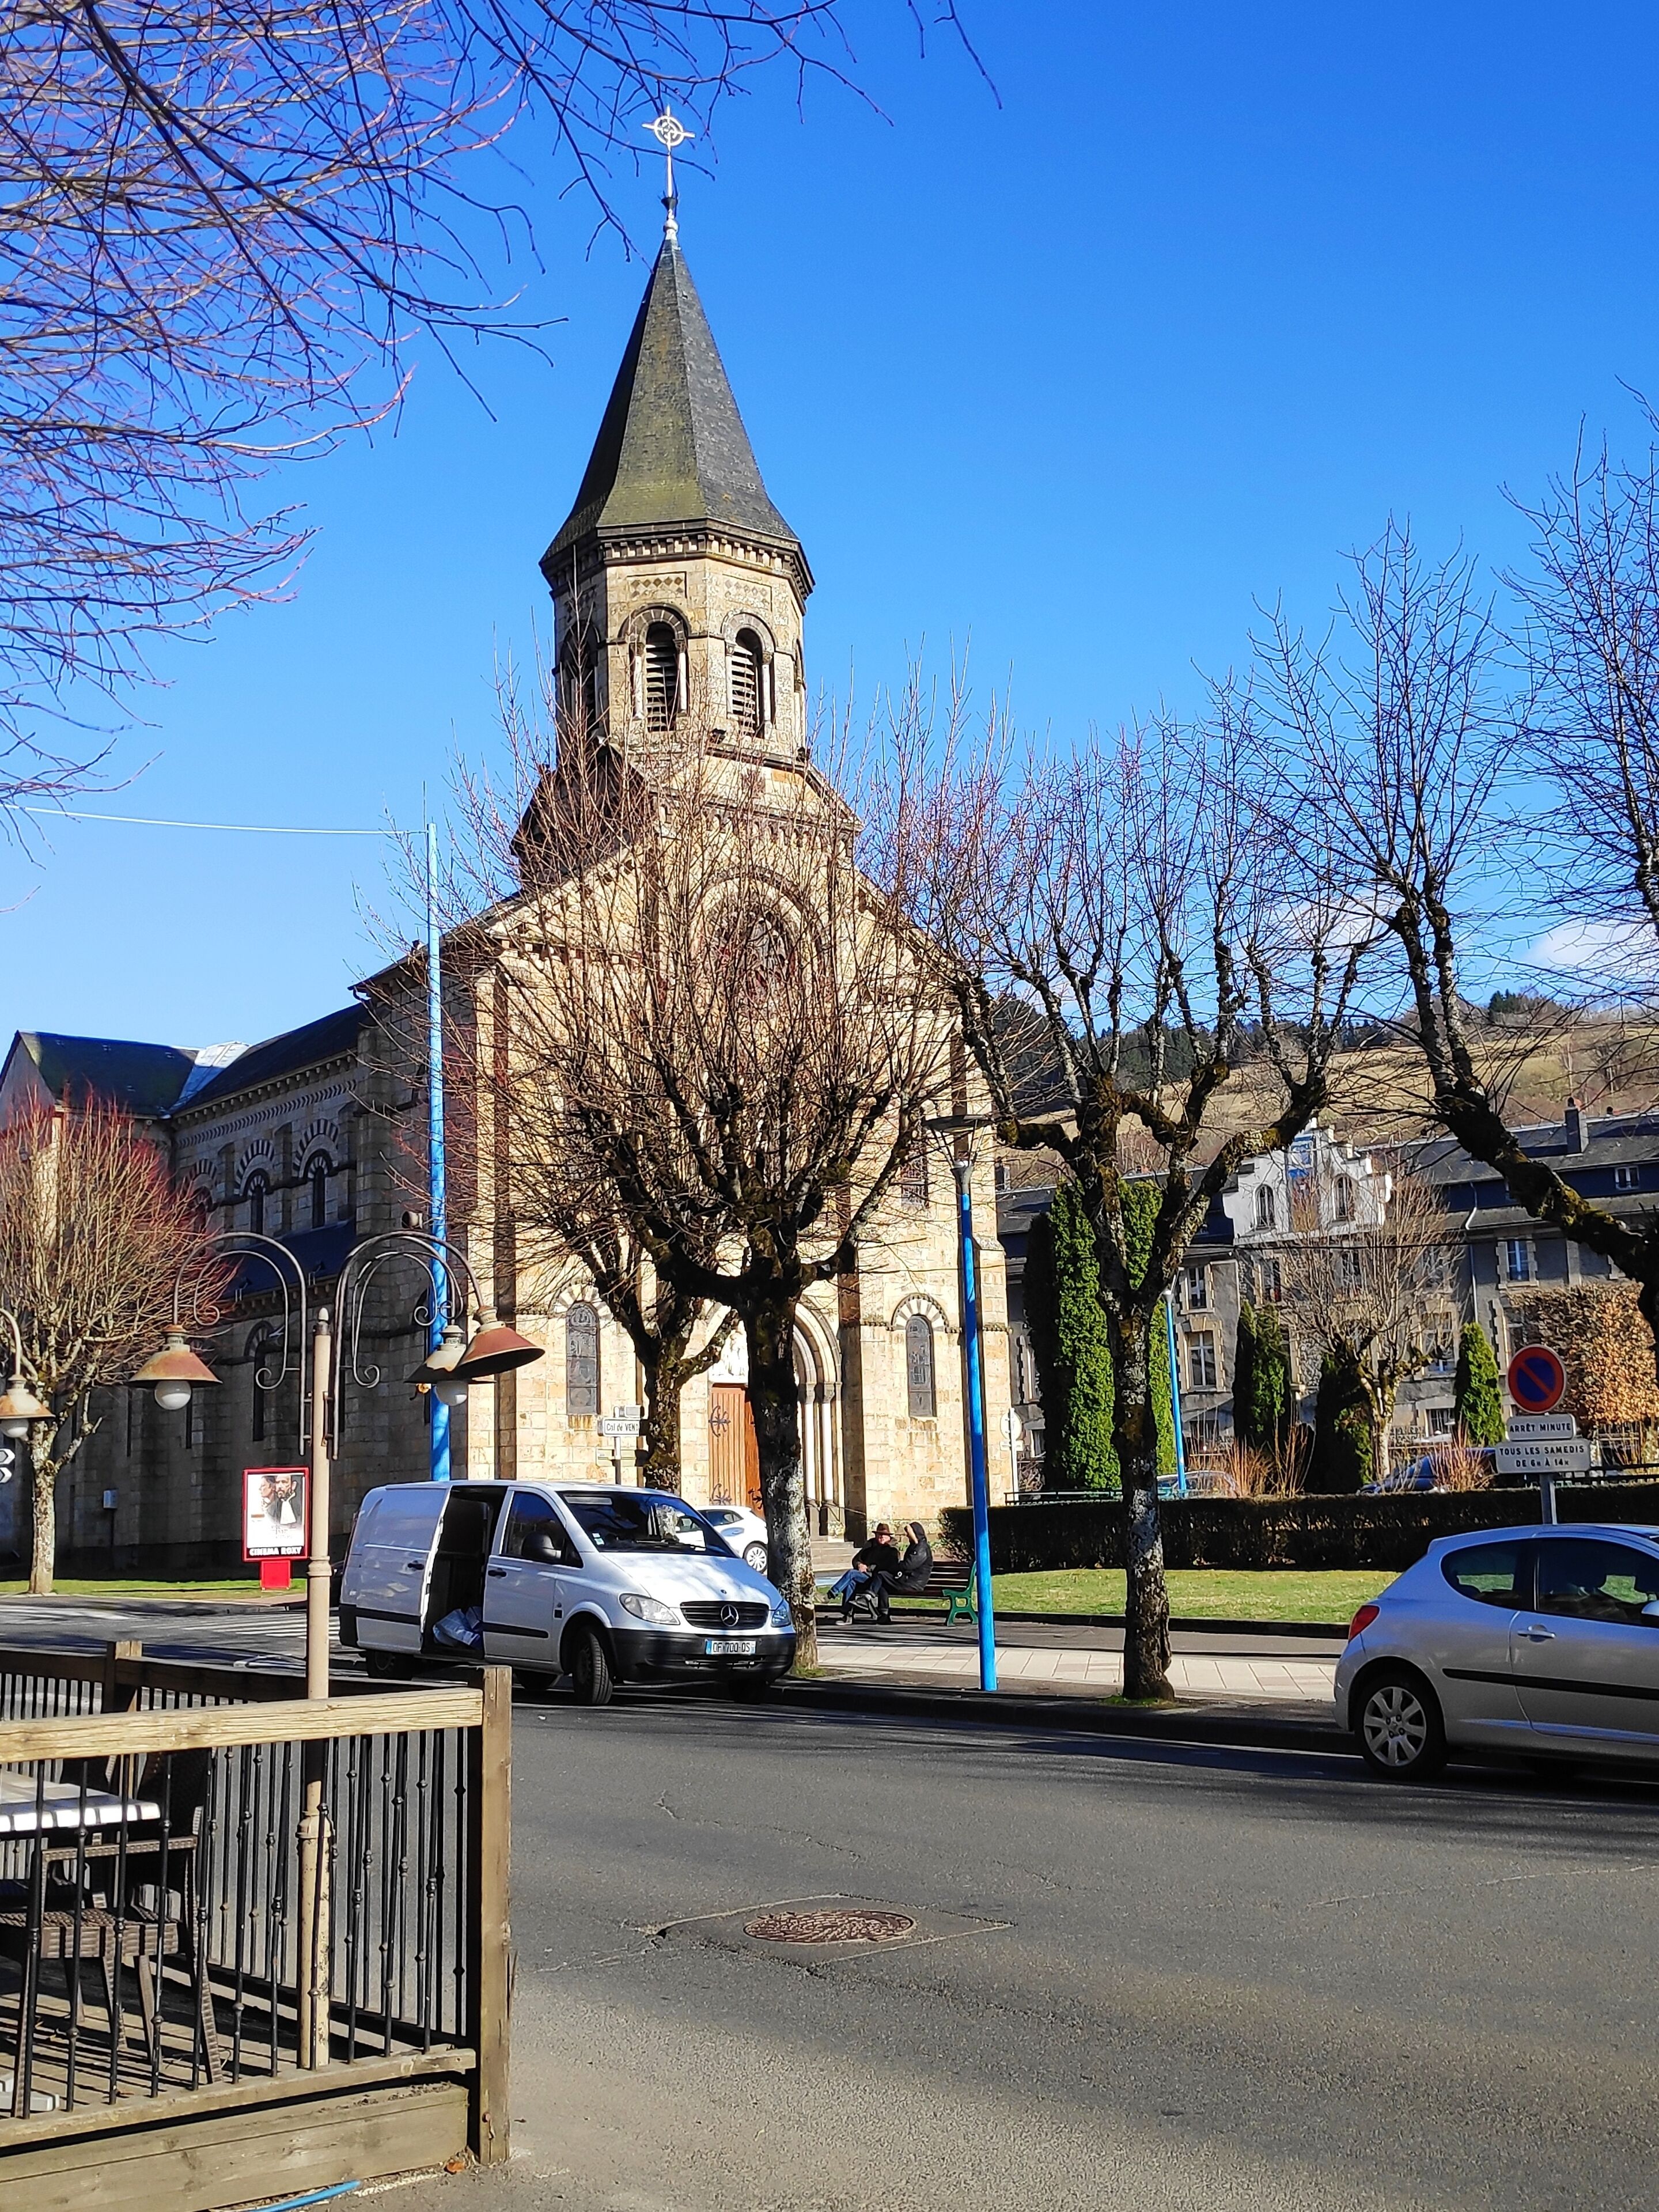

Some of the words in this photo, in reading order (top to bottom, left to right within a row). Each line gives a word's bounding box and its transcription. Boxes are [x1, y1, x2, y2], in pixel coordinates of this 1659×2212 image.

[1510, 1423, 1535, 1432] ARRÊT
[1540, 1423, 1571, 1431] MINUTE
[1525, 1447, 1540, 1455] LES
[1544, 1445, 1584, 1454] SAMEDIS
[1545, 1456, 1550, 1467] À
[281, 1546, 302, 1555] ROXY
